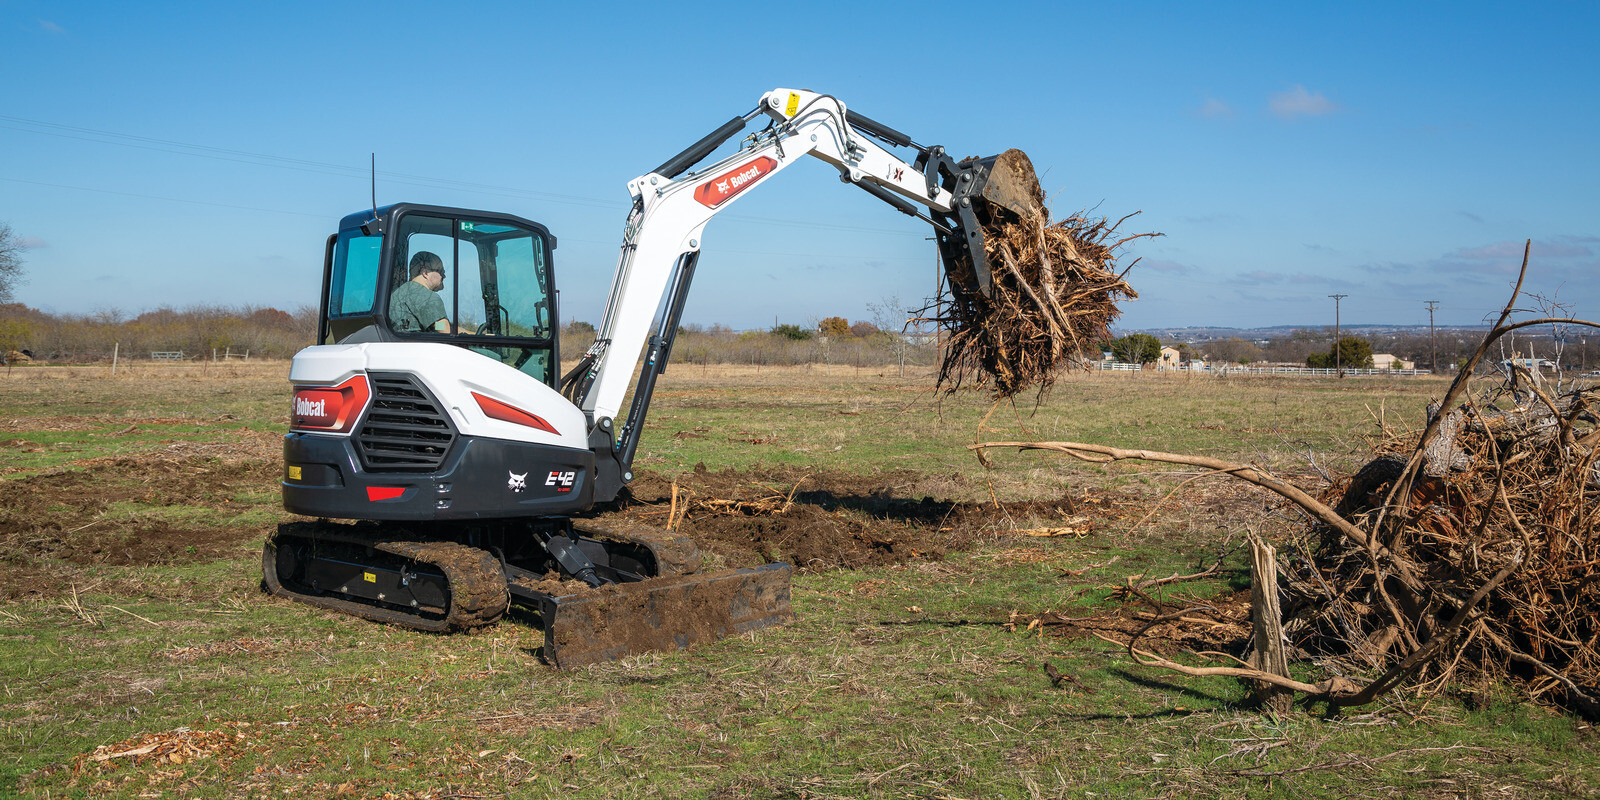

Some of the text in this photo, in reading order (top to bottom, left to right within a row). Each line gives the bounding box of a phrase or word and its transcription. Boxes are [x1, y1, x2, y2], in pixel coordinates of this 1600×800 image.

[730, 165, 760, 188] Bobcat
[296, 397, 326, 416] Bobcat
[544, 471, 575, 486] E42
